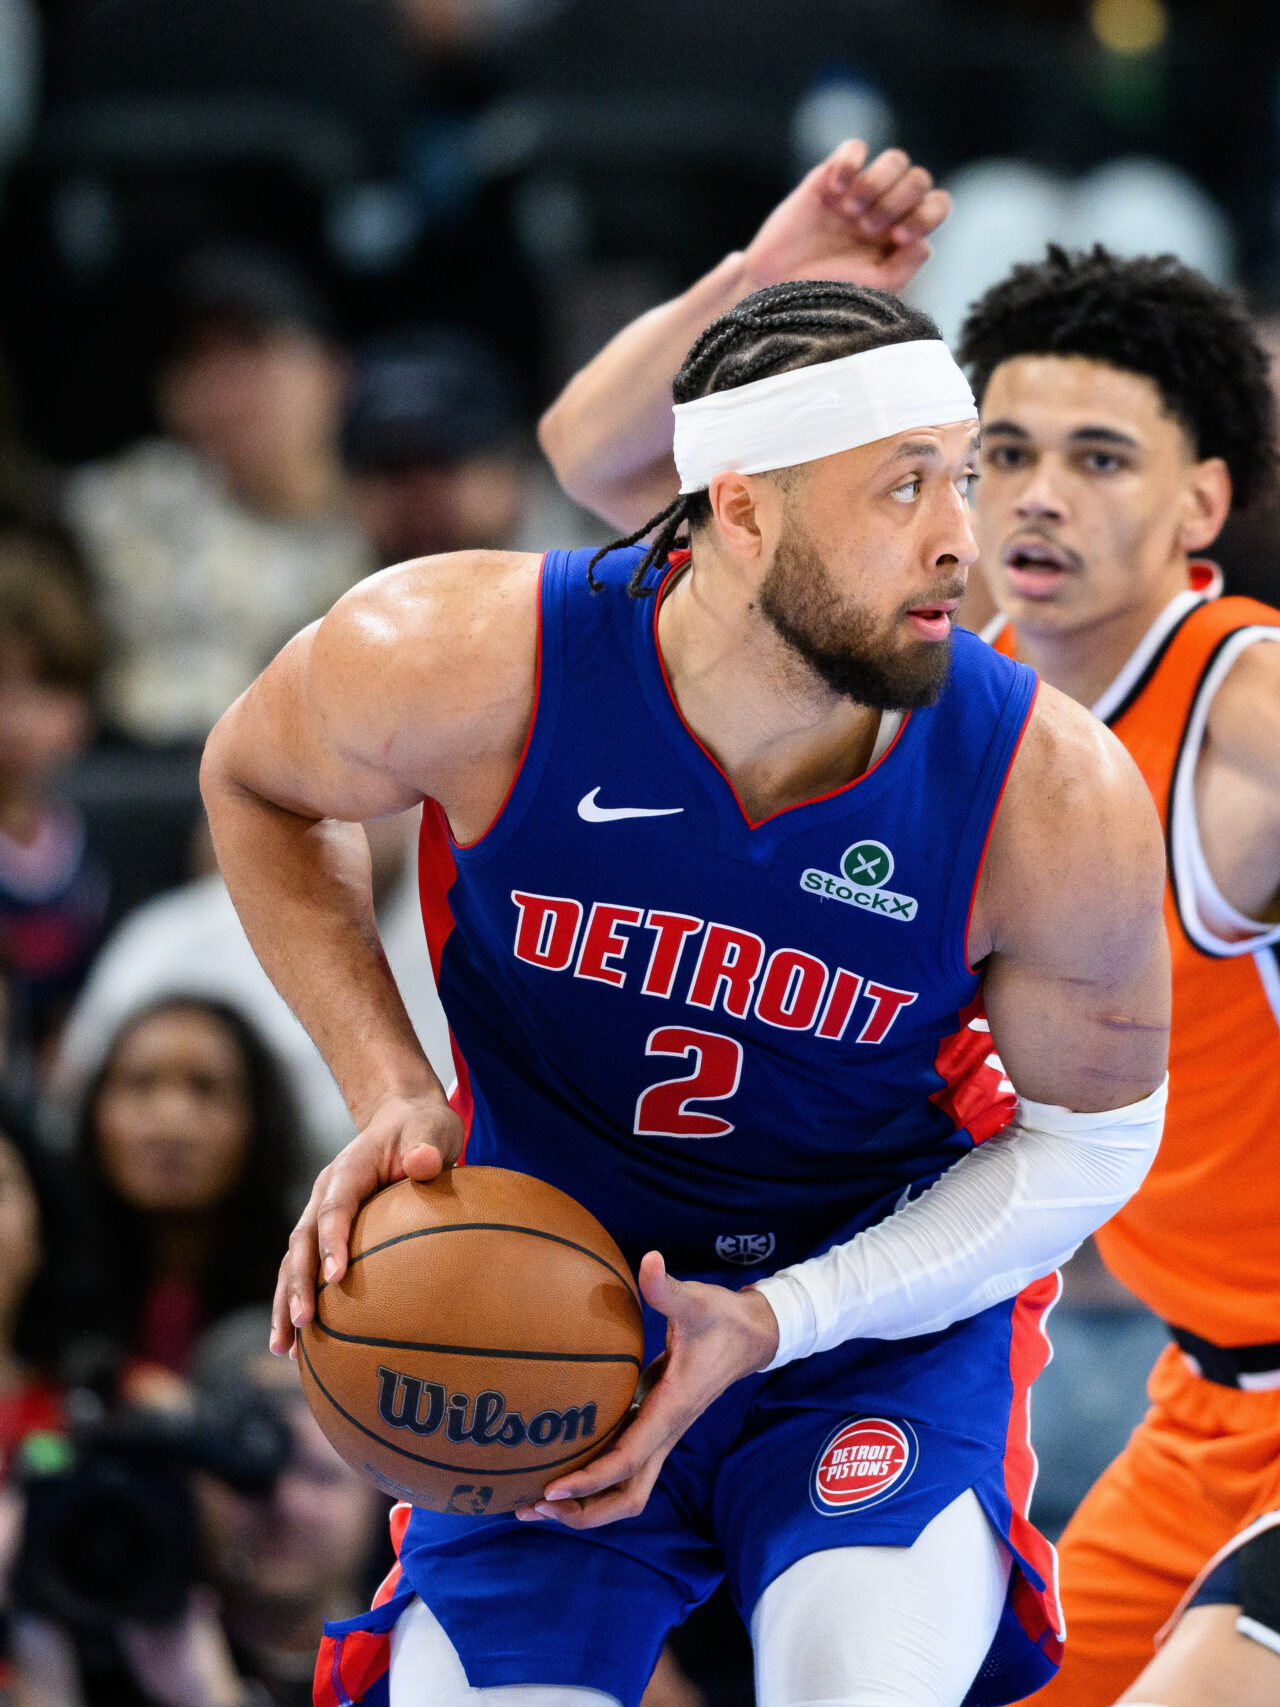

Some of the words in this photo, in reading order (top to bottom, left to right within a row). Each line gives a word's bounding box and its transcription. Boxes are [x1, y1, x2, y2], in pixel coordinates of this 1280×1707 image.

[804, 872, 914, 919] StockX
[511, 889, 919, 1045] DETROIT
[633, 1025, 744, 1139] 2
[376, 1365, 597, 1448] Wilson
[826, 1461, 891, 1482] PISTONS
[831, 1445, 896, 1465] DETROIT
